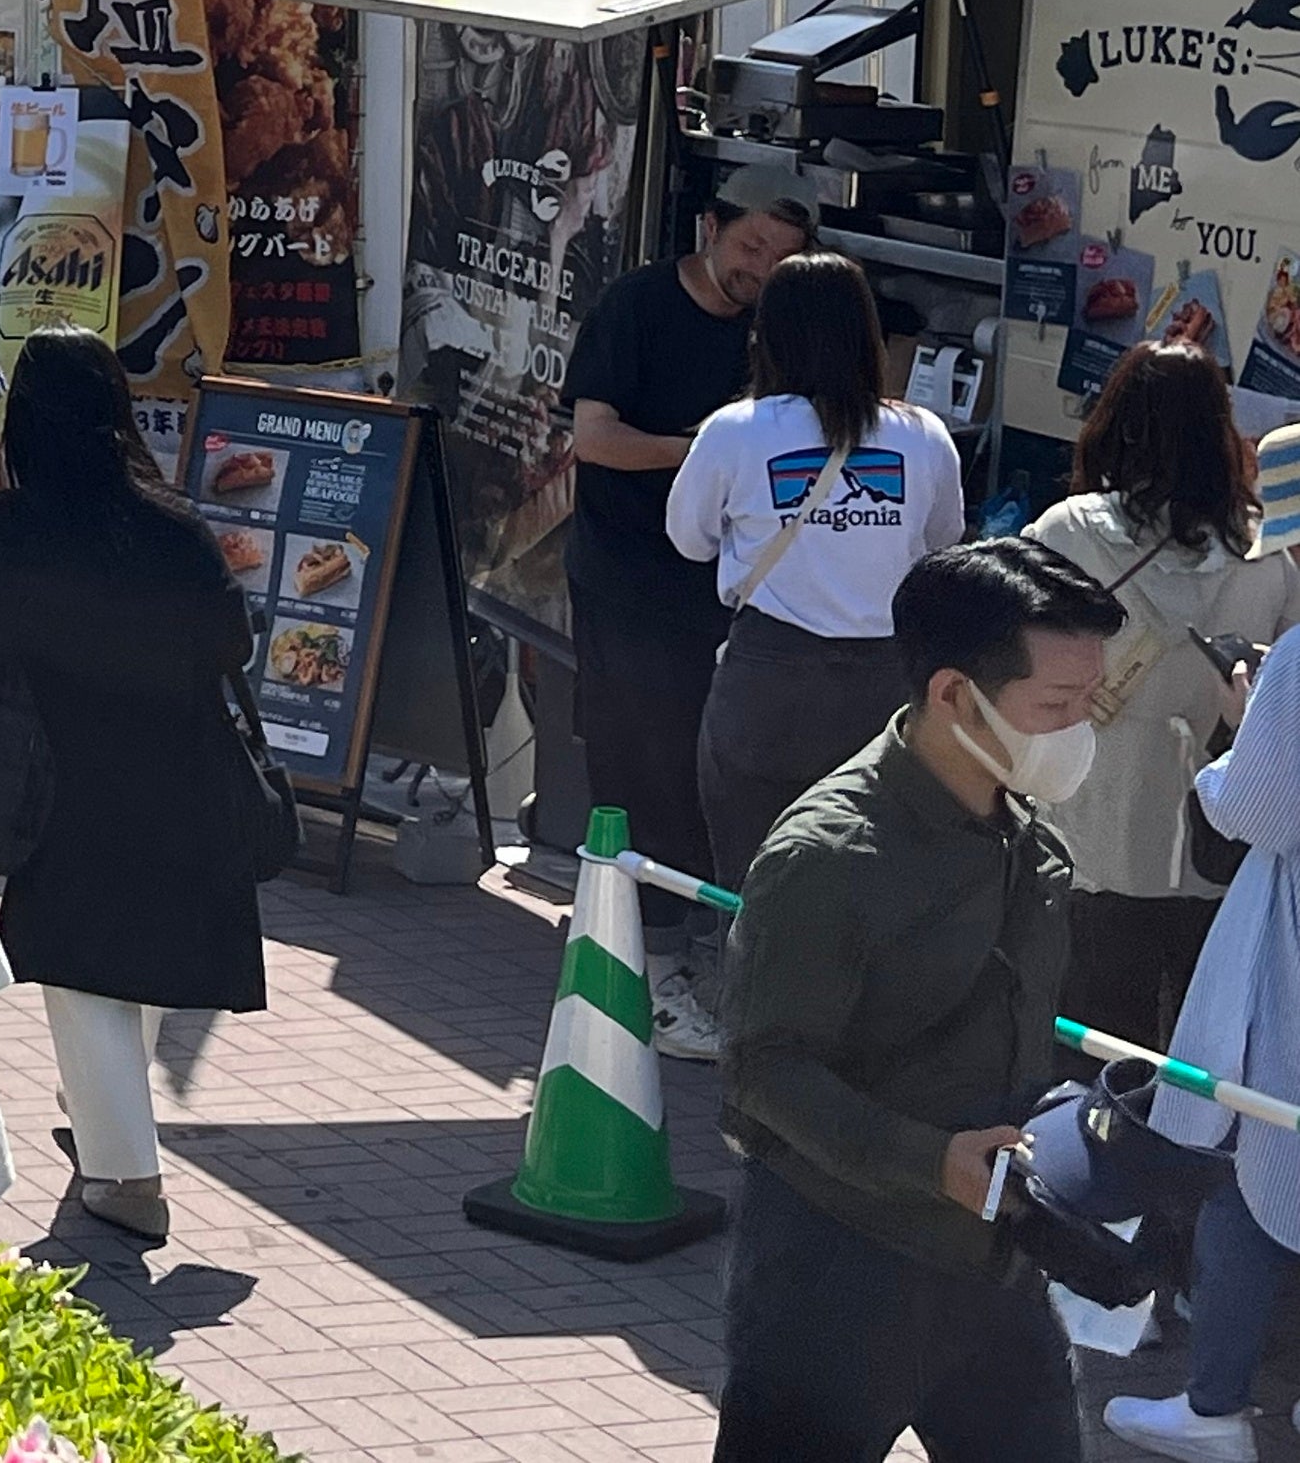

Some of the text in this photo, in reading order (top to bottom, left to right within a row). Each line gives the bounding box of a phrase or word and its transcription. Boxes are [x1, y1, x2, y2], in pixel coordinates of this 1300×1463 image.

[1098, 25, 1239, 76] LUKE'S
[494, 158, 541, 186] LUKE'S
[1088, 144, 1125, 194] from
[1136, 164, 1174, 194] ME
[1196, 221, 1262, 264] YOU.
[2, 246, 105, 292] Asahi
[456, 232, 575, 302] TRACEABLE
[35, 289, 55, 305] 生
[453, 273, 571, 341] SUSTAABLE
[257, 412, 342, 443] GRAND MENU
[779, 506, 902, 532] ptagonia
